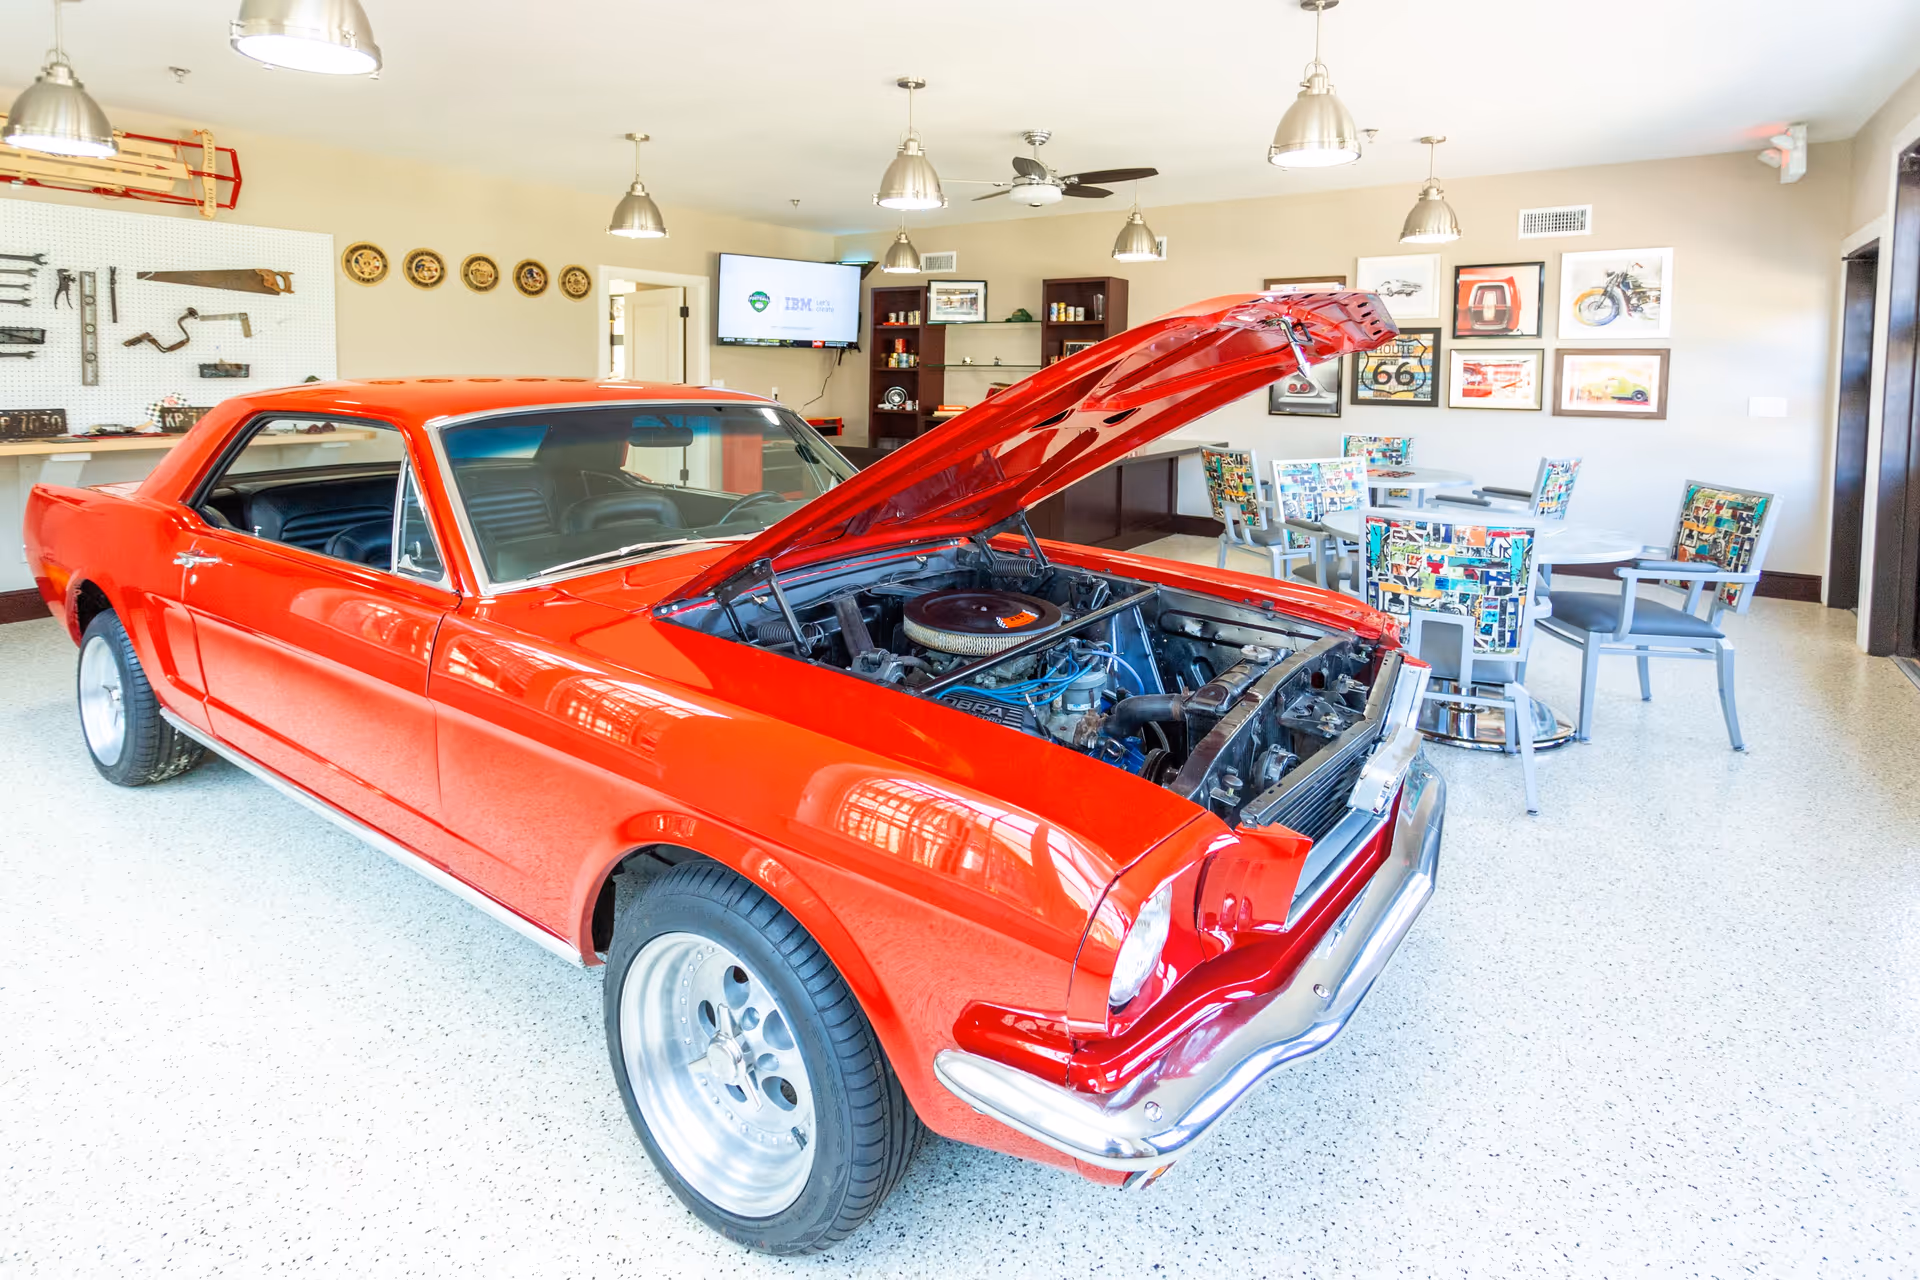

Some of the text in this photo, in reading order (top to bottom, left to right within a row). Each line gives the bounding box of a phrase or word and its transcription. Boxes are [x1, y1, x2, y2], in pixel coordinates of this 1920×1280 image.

[785, 297, 813, 312] IBM
[1375, 344, 1414, 355] ROUTE
[1373, 361, 1415, 386] 66
[943, 696, 1003, 717] OBRA
